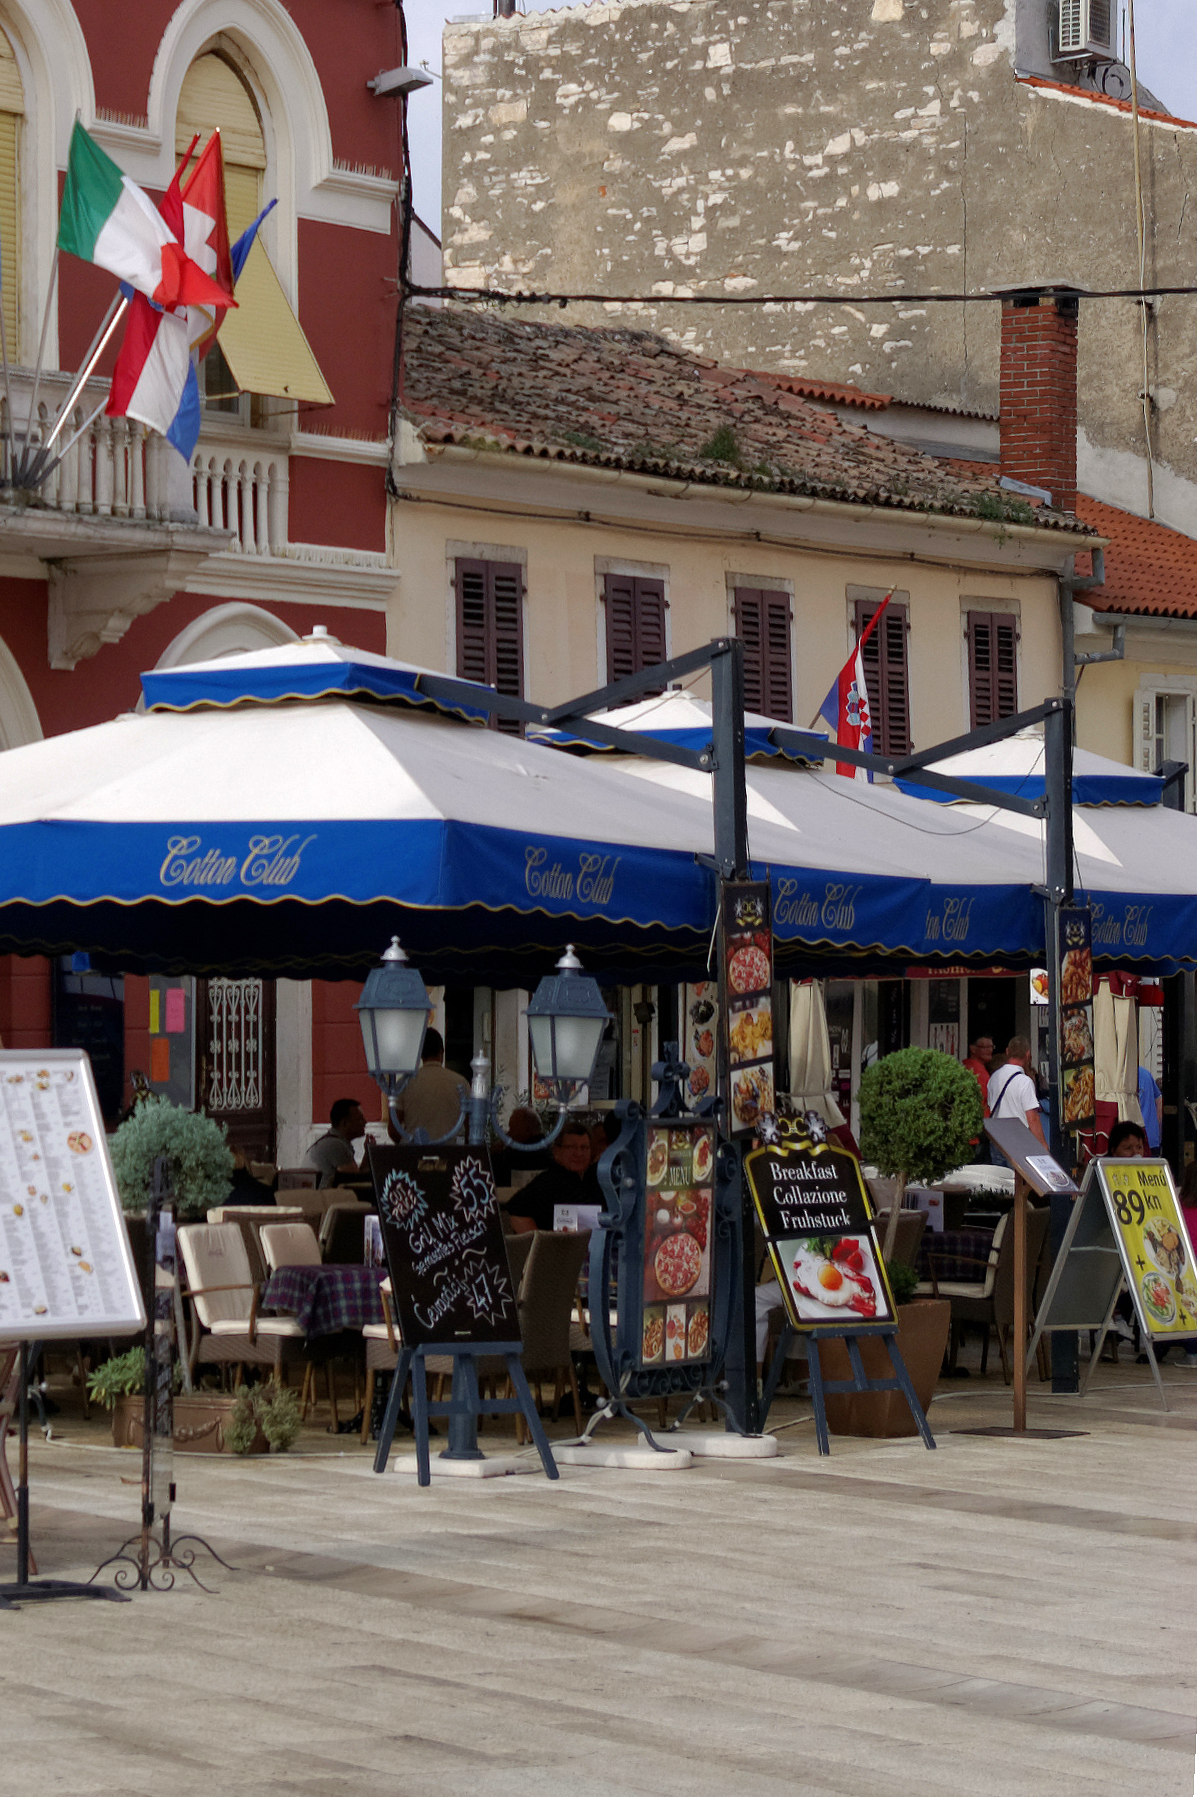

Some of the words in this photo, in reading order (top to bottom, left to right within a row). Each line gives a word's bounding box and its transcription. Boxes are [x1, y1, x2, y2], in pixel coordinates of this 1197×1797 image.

[159, 835, 237, 886] Cotton
[240, 834, 318, 886] Club
[525, 846, 573, 900] Cotton
[576, 853, 622, 904] Club
[773, 878, 819, 926] Cotton
[821, 883, 863, 930] Club
[942, 898, 975, 941] Club
[1123, 905, 1153, 946] Club
[459, 1166, 490, 1212] 55
[669, 1166, 691, 1186] MENU
[769, 1160, 838, 1181] Breakfast
[1136, 1169, 1166, 1187] Menú
[773, 1185, 847, 1205] Collazione
[1113, 1189, 1145, 1226] 89
[1142, 1189, 1162, 1210] kn
[431, 1211, 459, 1238] Mix
[779, 1208, 851, 1229] Fruhstuck
[472, 1273, 492, 1311] 47
